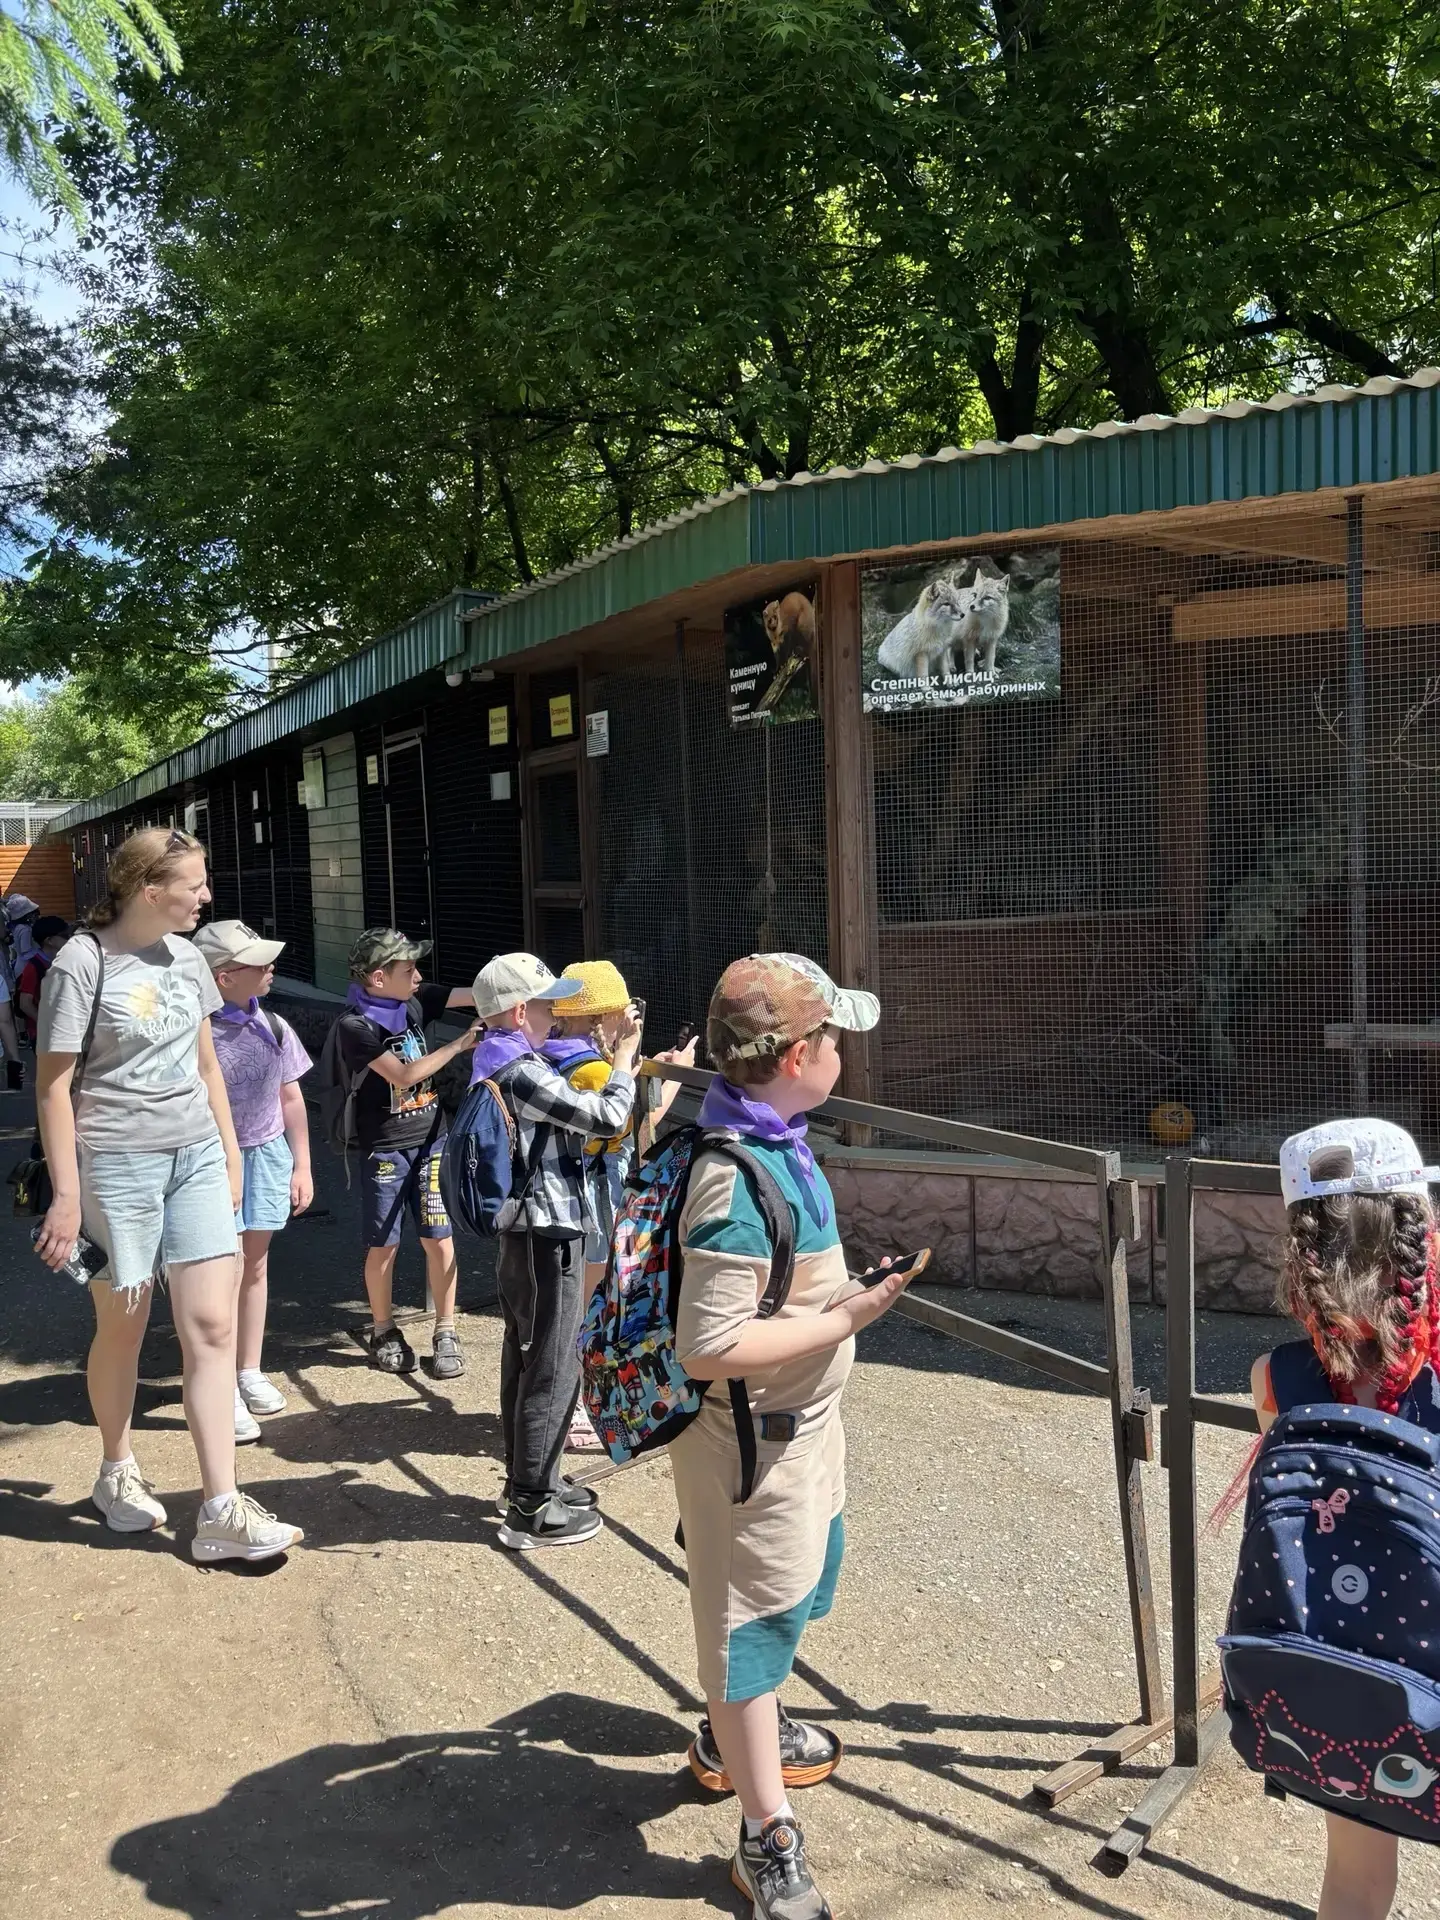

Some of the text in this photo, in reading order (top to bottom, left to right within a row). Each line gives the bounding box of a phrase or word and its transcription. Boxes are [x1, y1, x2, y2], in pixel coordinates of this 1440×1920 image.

[729, 661, 767, 679] Каменную
[730, 678, 756, 694] куницу
[871, 671, 994, 692] Степных лисиц
[871, 681, 1046, 705] опекает семья Бабуриных
[115, 1011, 200, 1041] HARMONY
